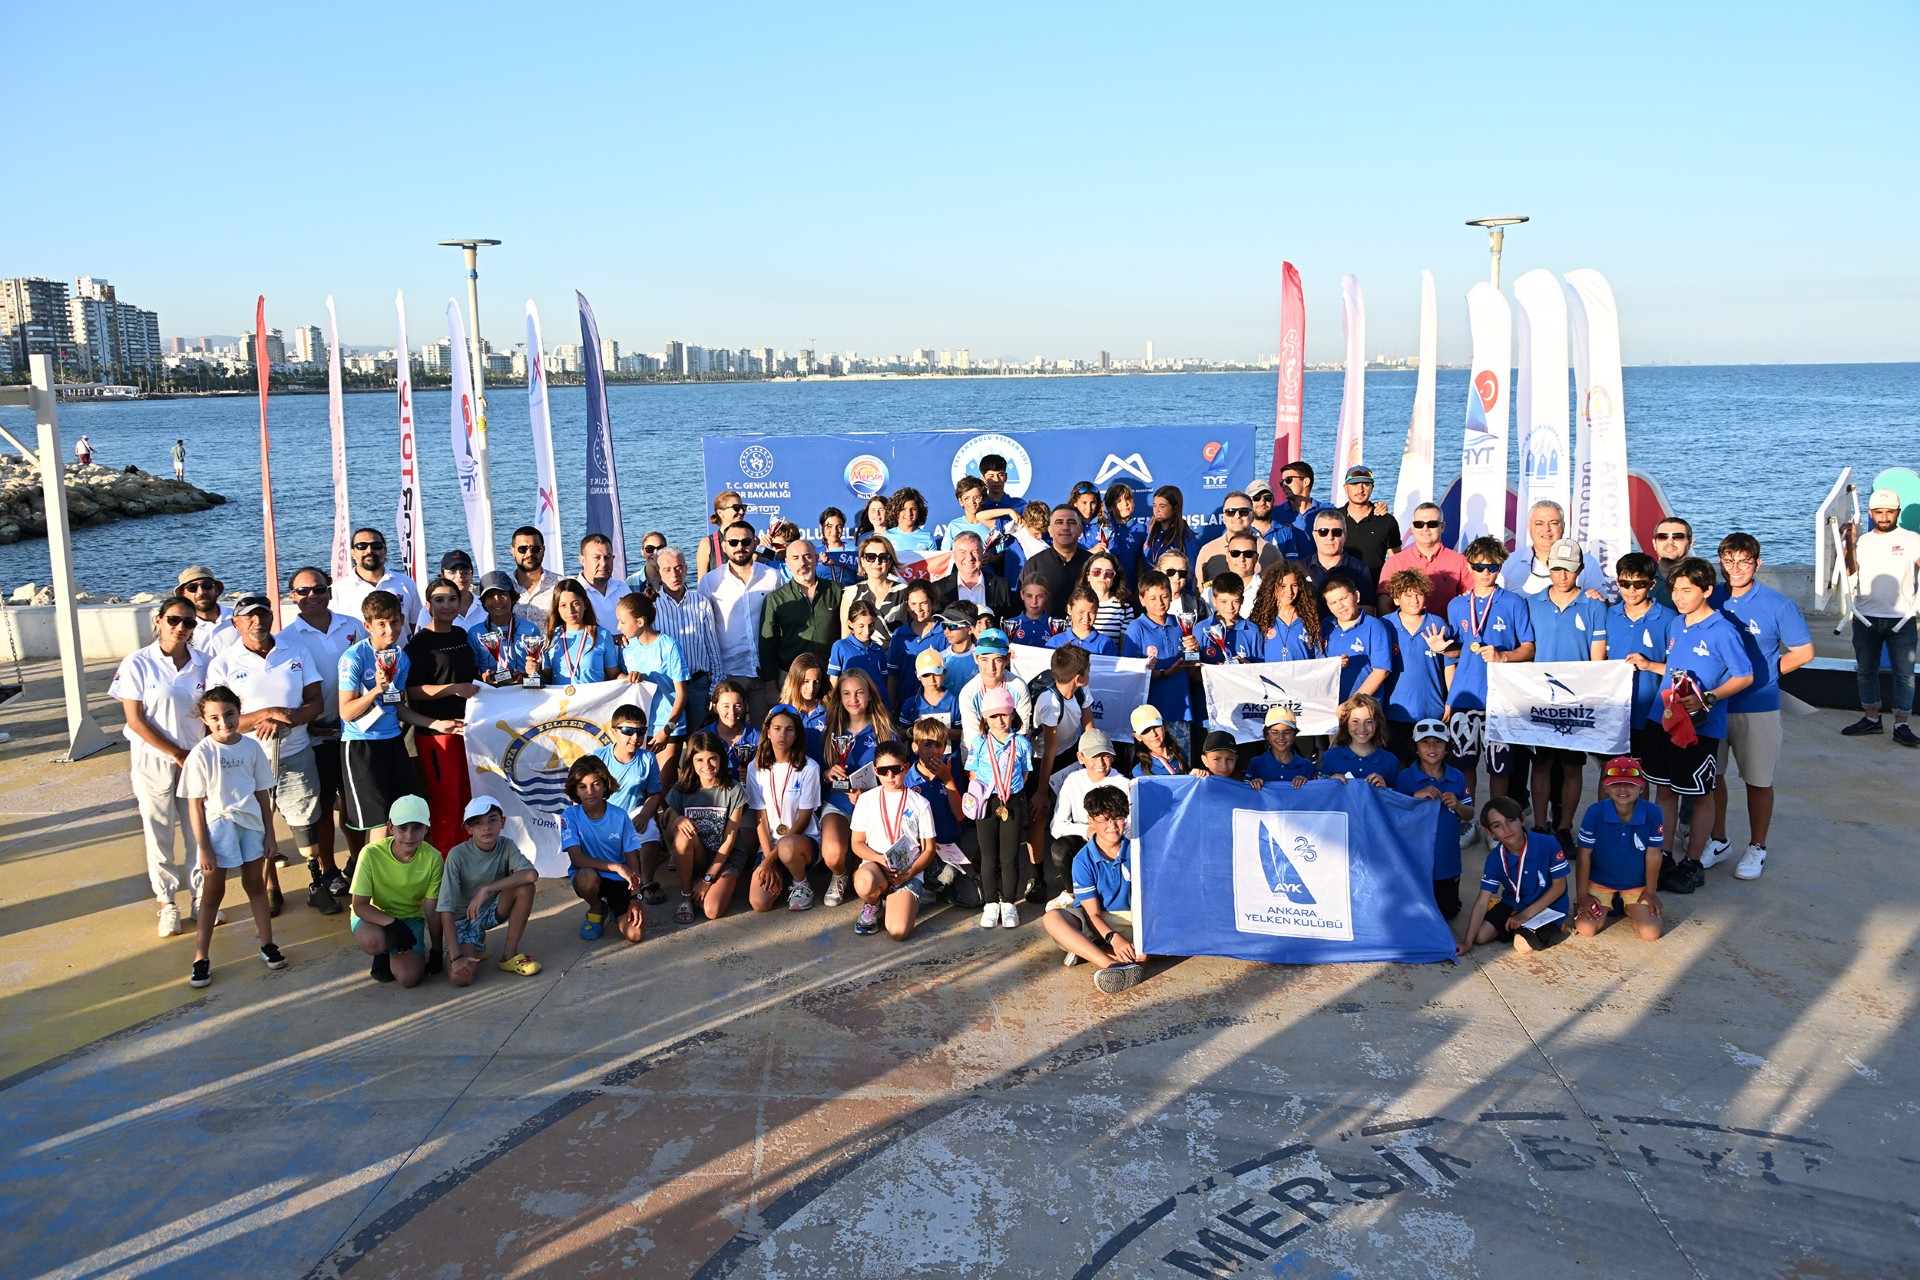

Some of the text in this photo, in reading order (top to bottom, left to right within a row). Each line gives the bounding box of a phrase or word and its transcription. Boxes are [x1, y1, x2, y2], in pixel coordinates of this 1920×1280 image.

[743, 481, 778, 491] GENÇLİK
[778, 481, 790, 489] VE
[1202, 475, 1229, 485] TYF
[747, 489, 791, 499] BAKANLIĞI
[1530, 703, 1595, 720] AKDENİZ
[537, 720, 586, 732] YELKEN
[1273, 882, 1303, 894] AYK
[1267, 906, 1318, 918] ANKARA
[1244, 913, 1343, 929] YELKEN KULÜBÜ
